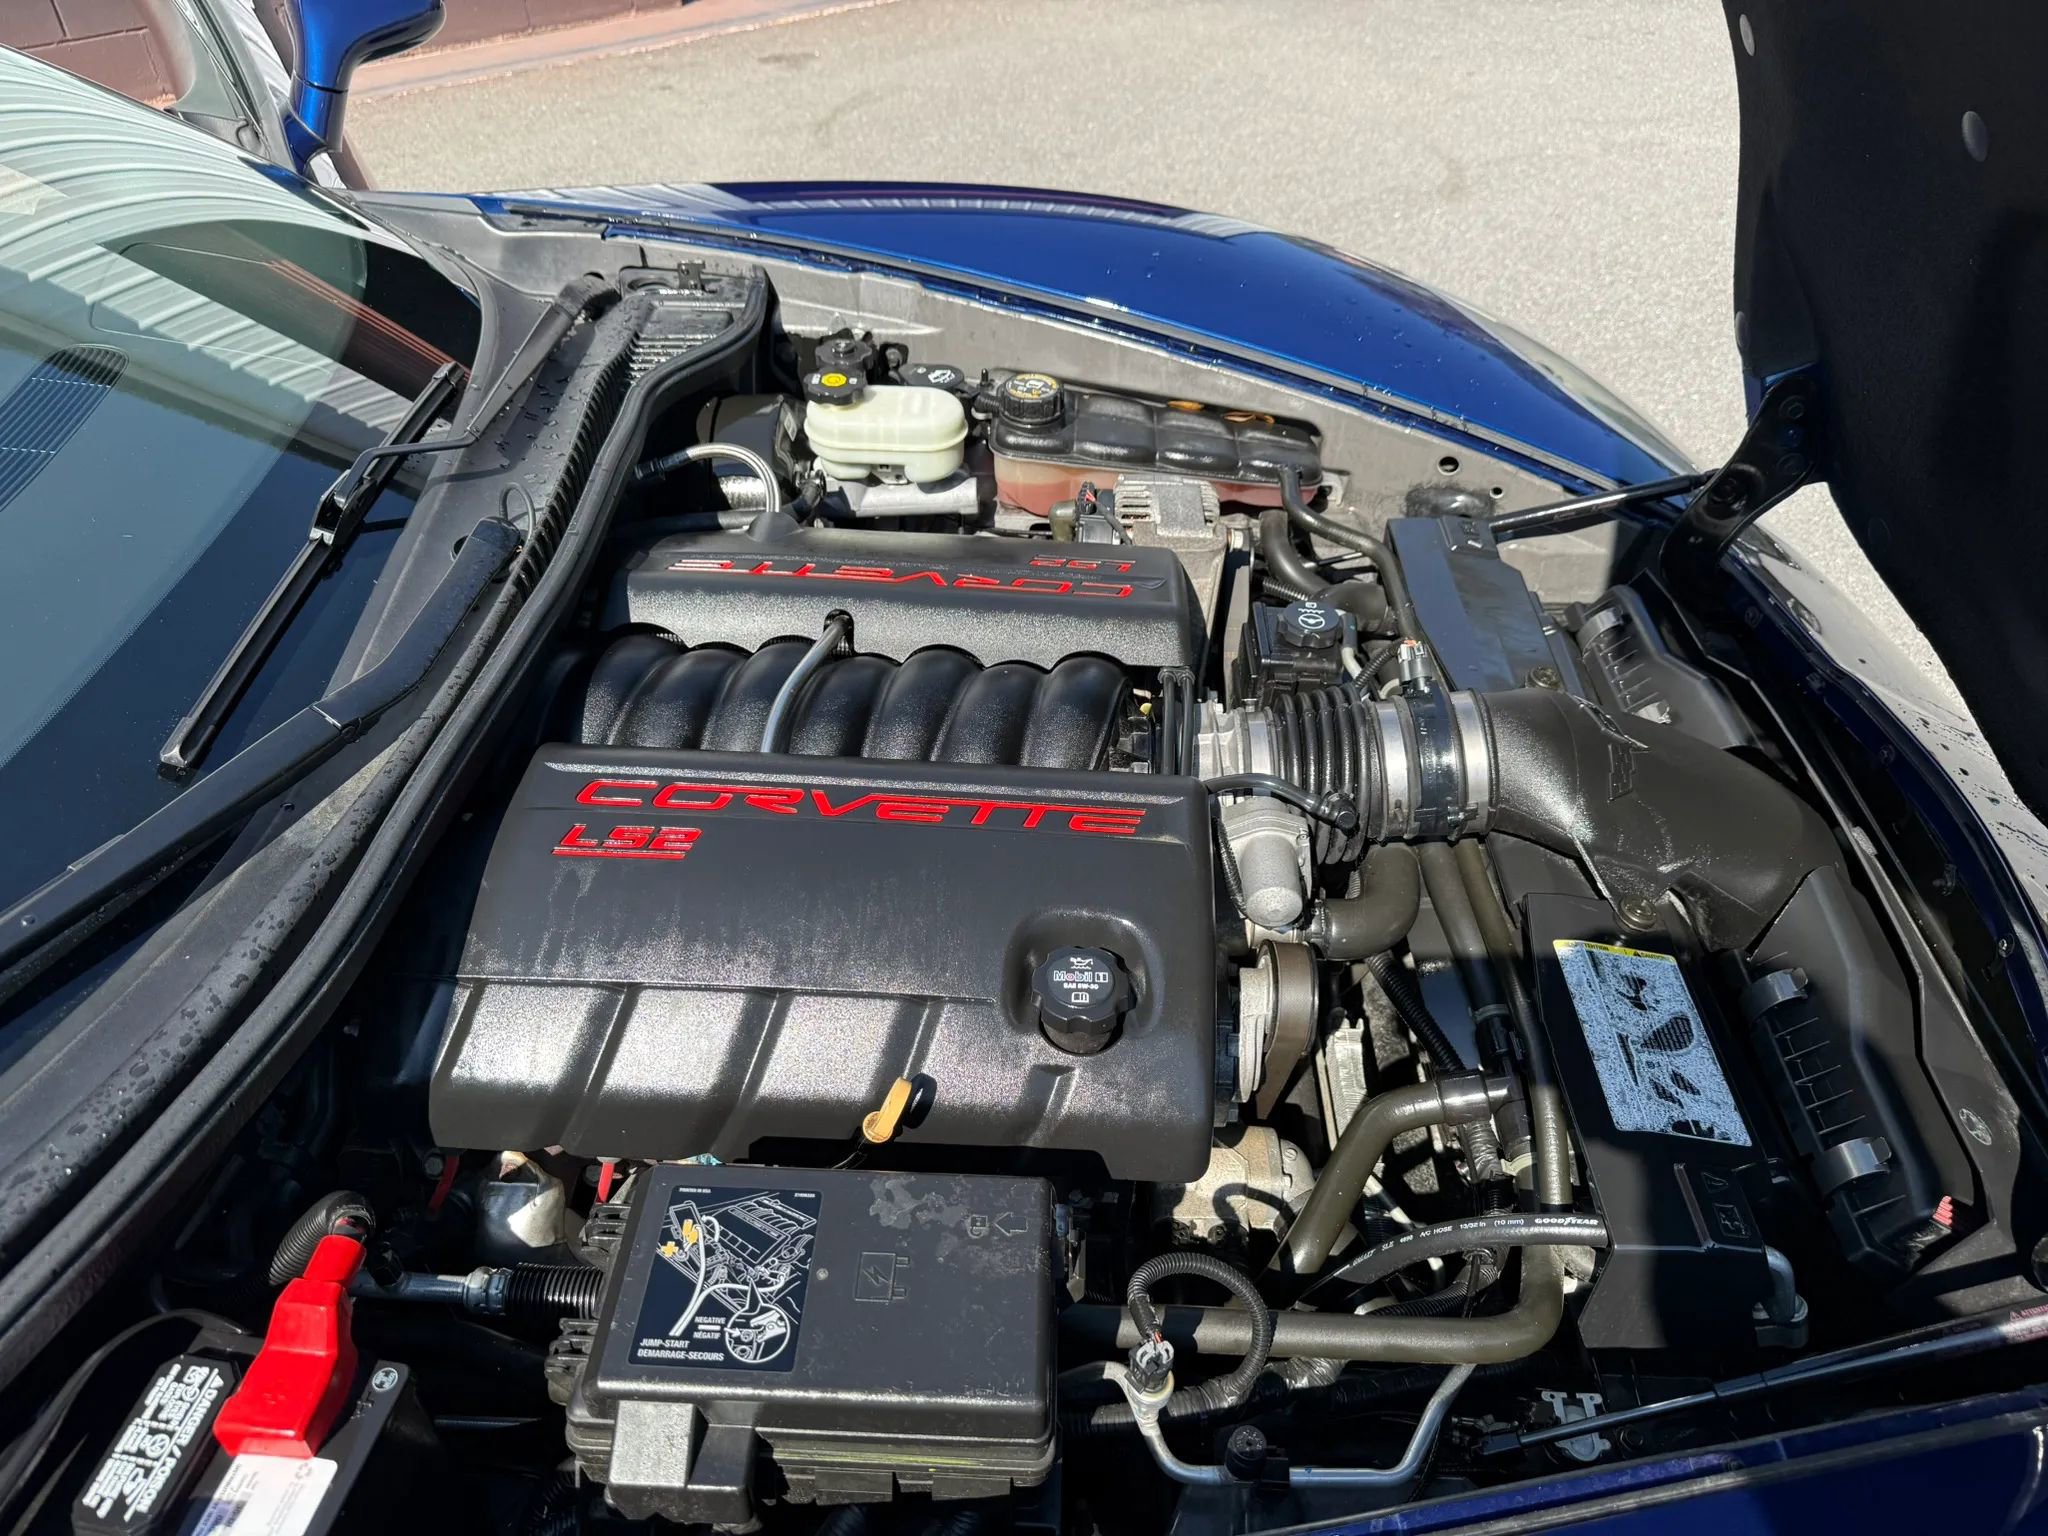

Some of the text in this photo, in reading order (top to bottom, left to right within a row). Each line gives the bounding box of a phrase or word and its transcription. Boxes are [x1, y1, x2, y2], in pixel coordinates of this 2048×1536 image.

[1028, 555, 1137, 573] LS2
[667, 559, 1133, 598] CORVETTE
[576, 779, 1147, 835] CORVETTE
[555, 823, 702, 856] LS2
[1053, 970, 1093, 983] Mobil
[1420, 1230, 1431, 1238] A/C
[1434, 1226, 1453, 1234] HOSE
[1460, 1221, 1478, 1230] 13/32
[1534, 1217, 1599, 1226] GOODYEAR
[694, 1316, 726, 1325] NEGATIVE
[640, 1338, 690, 1348] JUMP-START
[175, 1385, 218, 1447] DANGER
[135, 1456, 178, 1514] POISON
